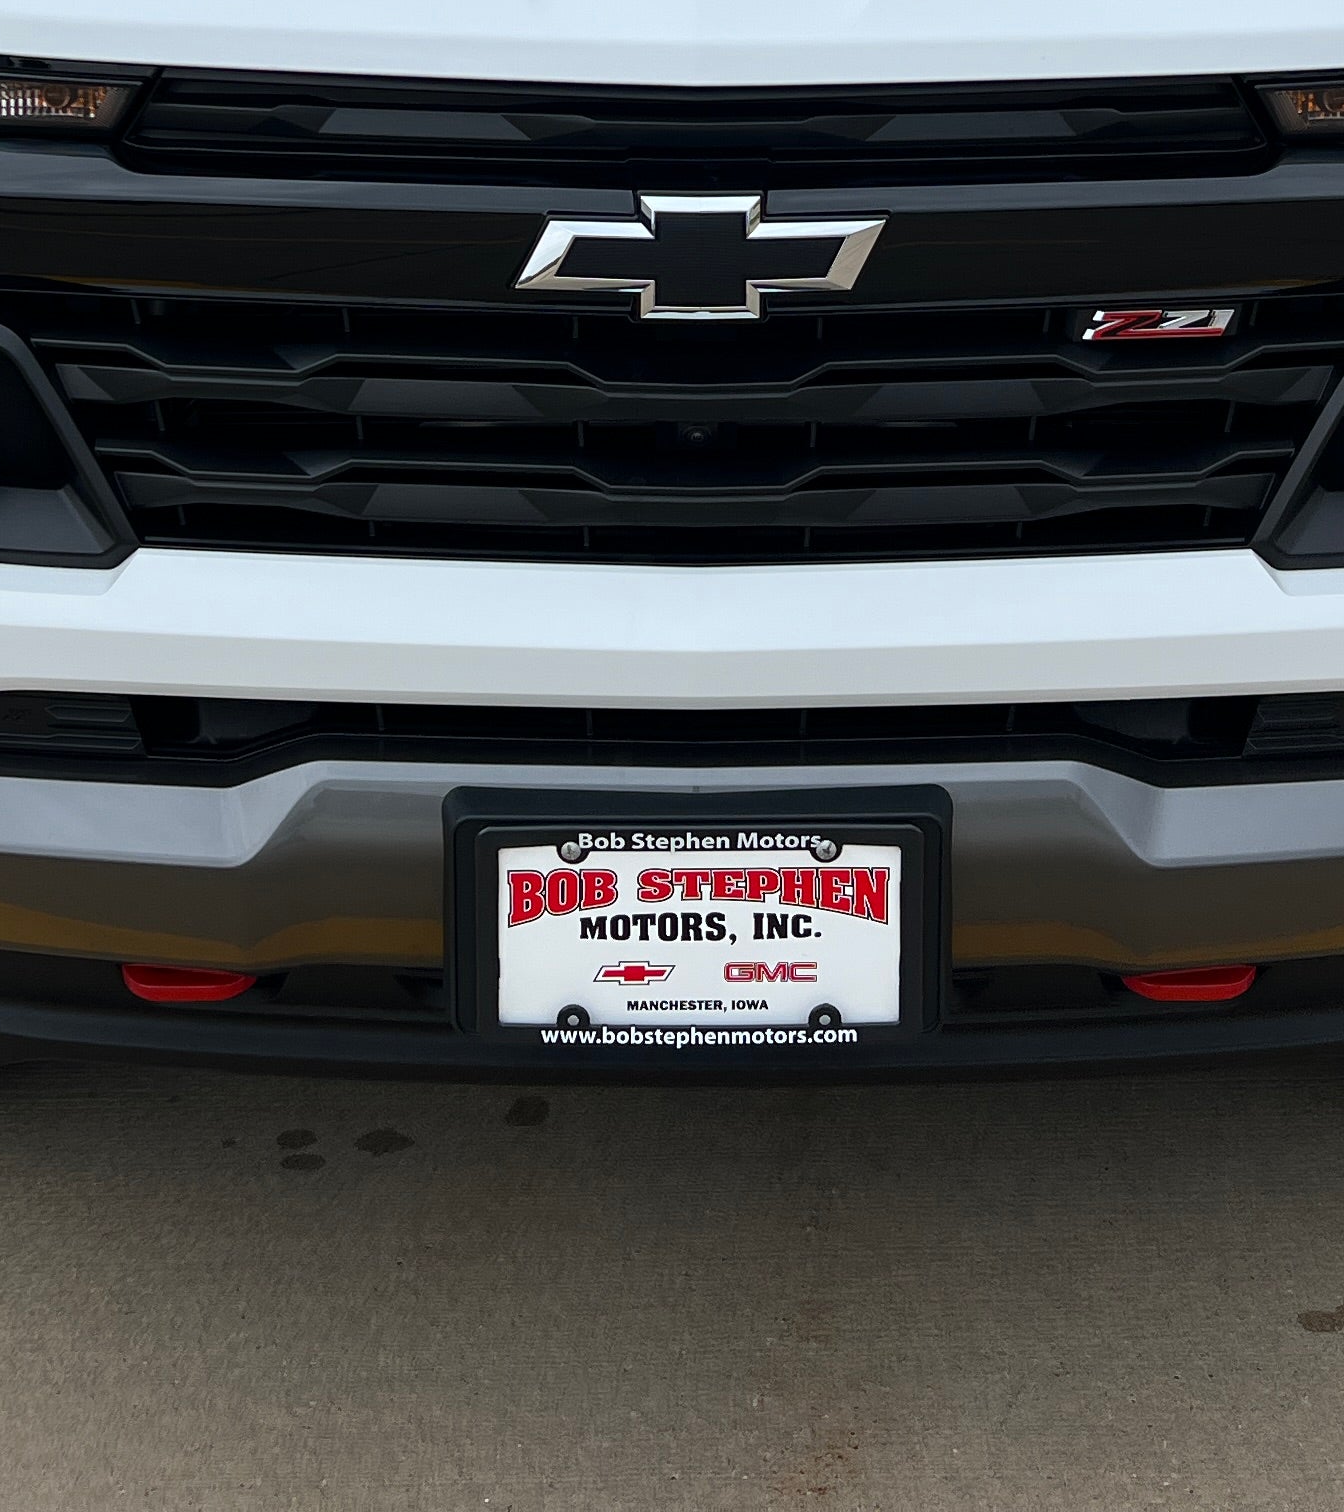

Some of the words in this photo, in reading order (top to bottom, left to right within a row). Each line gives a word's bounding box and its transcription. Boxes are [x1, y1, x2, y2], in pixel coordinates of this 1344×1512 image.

[1082, 309, 1235, 340] Z71
[578, 832, 626, 849] Bob
[631, 832, 730, 855] Stephen
[737, 832, 822, 849] Motors
[507, 868, 619, 928] BOB
[637, 867, 891, 925] STEPHEN
[579, 912, 737, 945] MOTORS,
[752, 912, 822, 940] INC.
[724, 961, 818, 982] GMC
[626, 1000, 728, 1014] MANCHESTER,
[731, 999, 769, 1011] IOWA
[541, 1025, 858, 1049] www.bobstephenmotors.com
